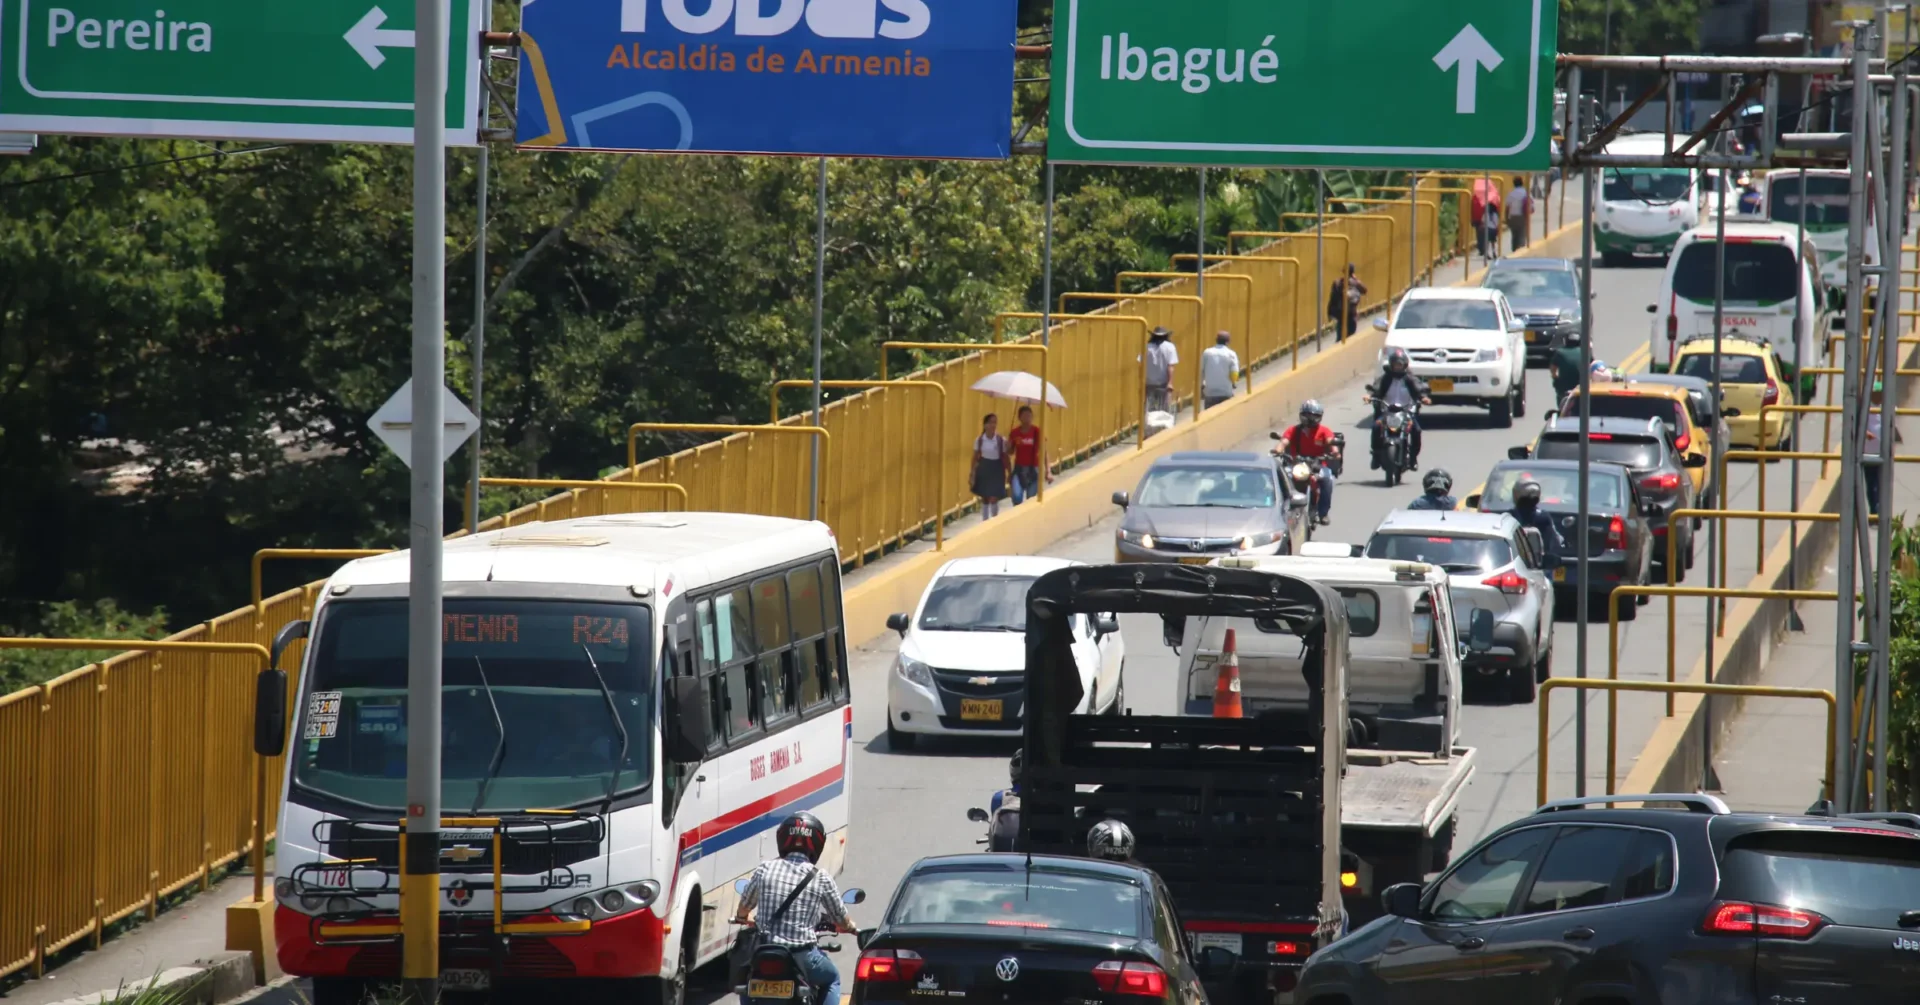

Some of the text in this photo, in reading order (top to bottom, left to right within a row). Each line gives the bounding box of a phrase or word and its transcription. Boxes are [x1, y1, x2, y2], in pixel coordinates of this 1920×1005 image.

[47, 8, 212, 53] Pereira
[606, 43, 931, 77] Alcaldía de Armenia
[1100, 32, 1279, 94] Ibagué
[1713, 316, 1757, 327] ISSAN
[443, 614, 629, 643] MENIA R24
[770, 745, 790, 774] ARMENIA
[1892, 936, 1920, 953] Jee
[910, 988, 946, 996] VOYAGE
